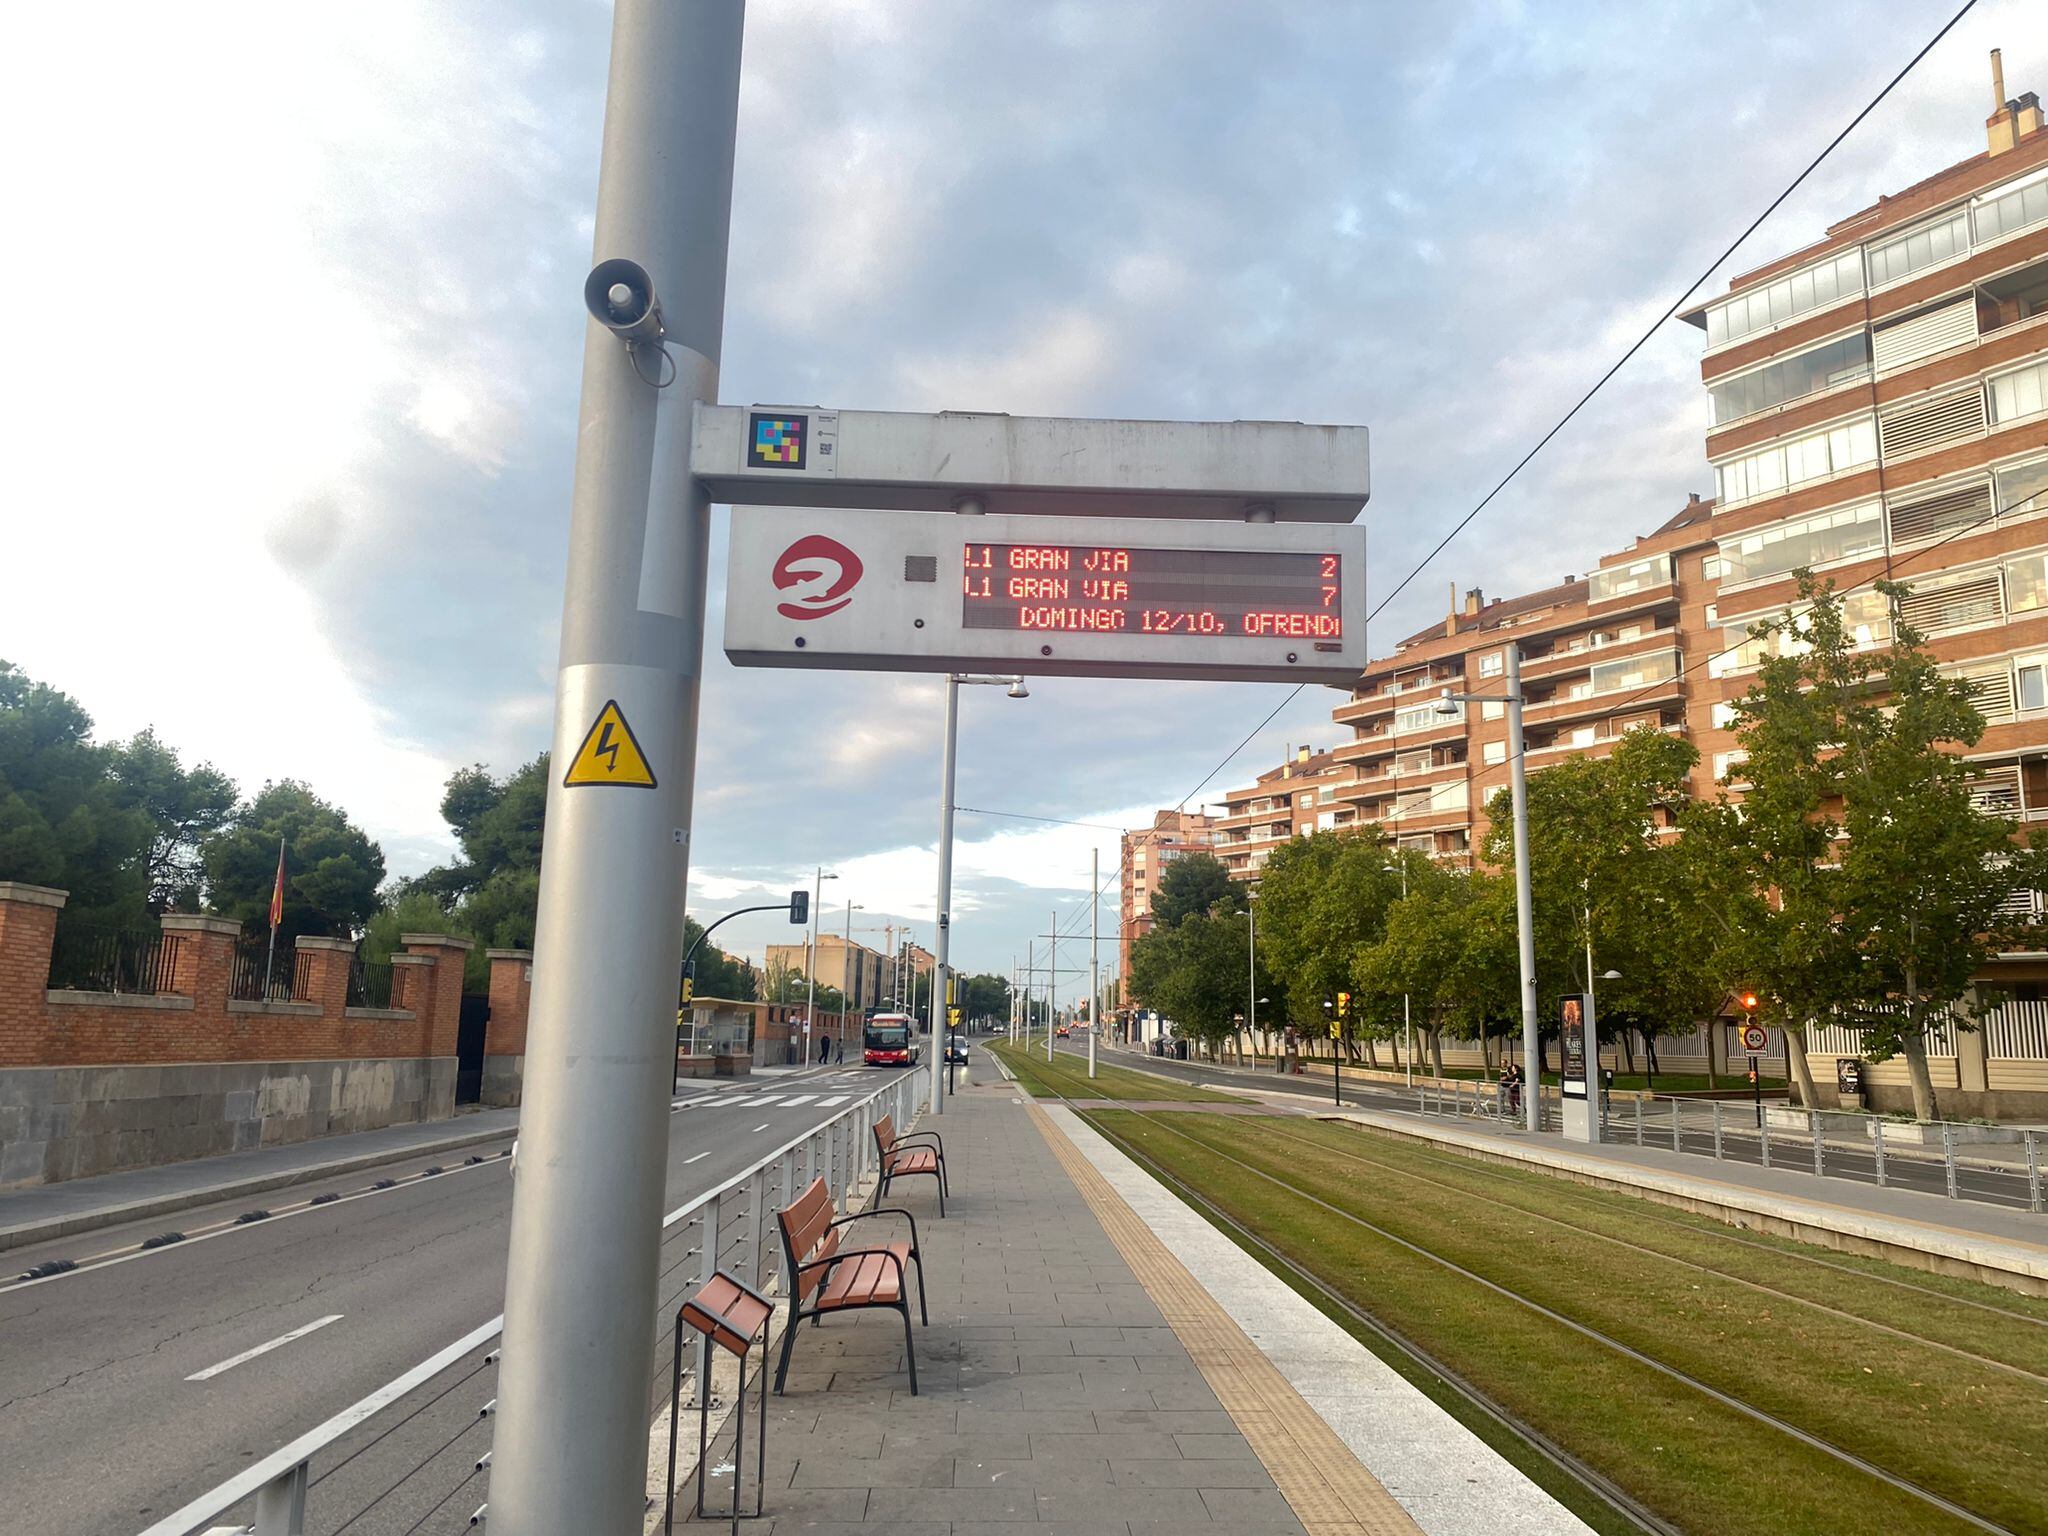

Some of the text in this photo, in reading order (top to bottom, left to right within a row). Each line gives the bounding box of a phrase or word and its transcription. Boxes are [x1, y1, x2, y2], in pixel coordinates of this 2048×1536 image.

[965, 547, 1336, 577] L1 GRAN VIA 2
[964, 576, 1337, 607] L1 GRAN VIA 7
[1021, 606, 1340, 636] DOMINGO 12/10, OFREND
[1749, 1033, 1762, 1042] 50
